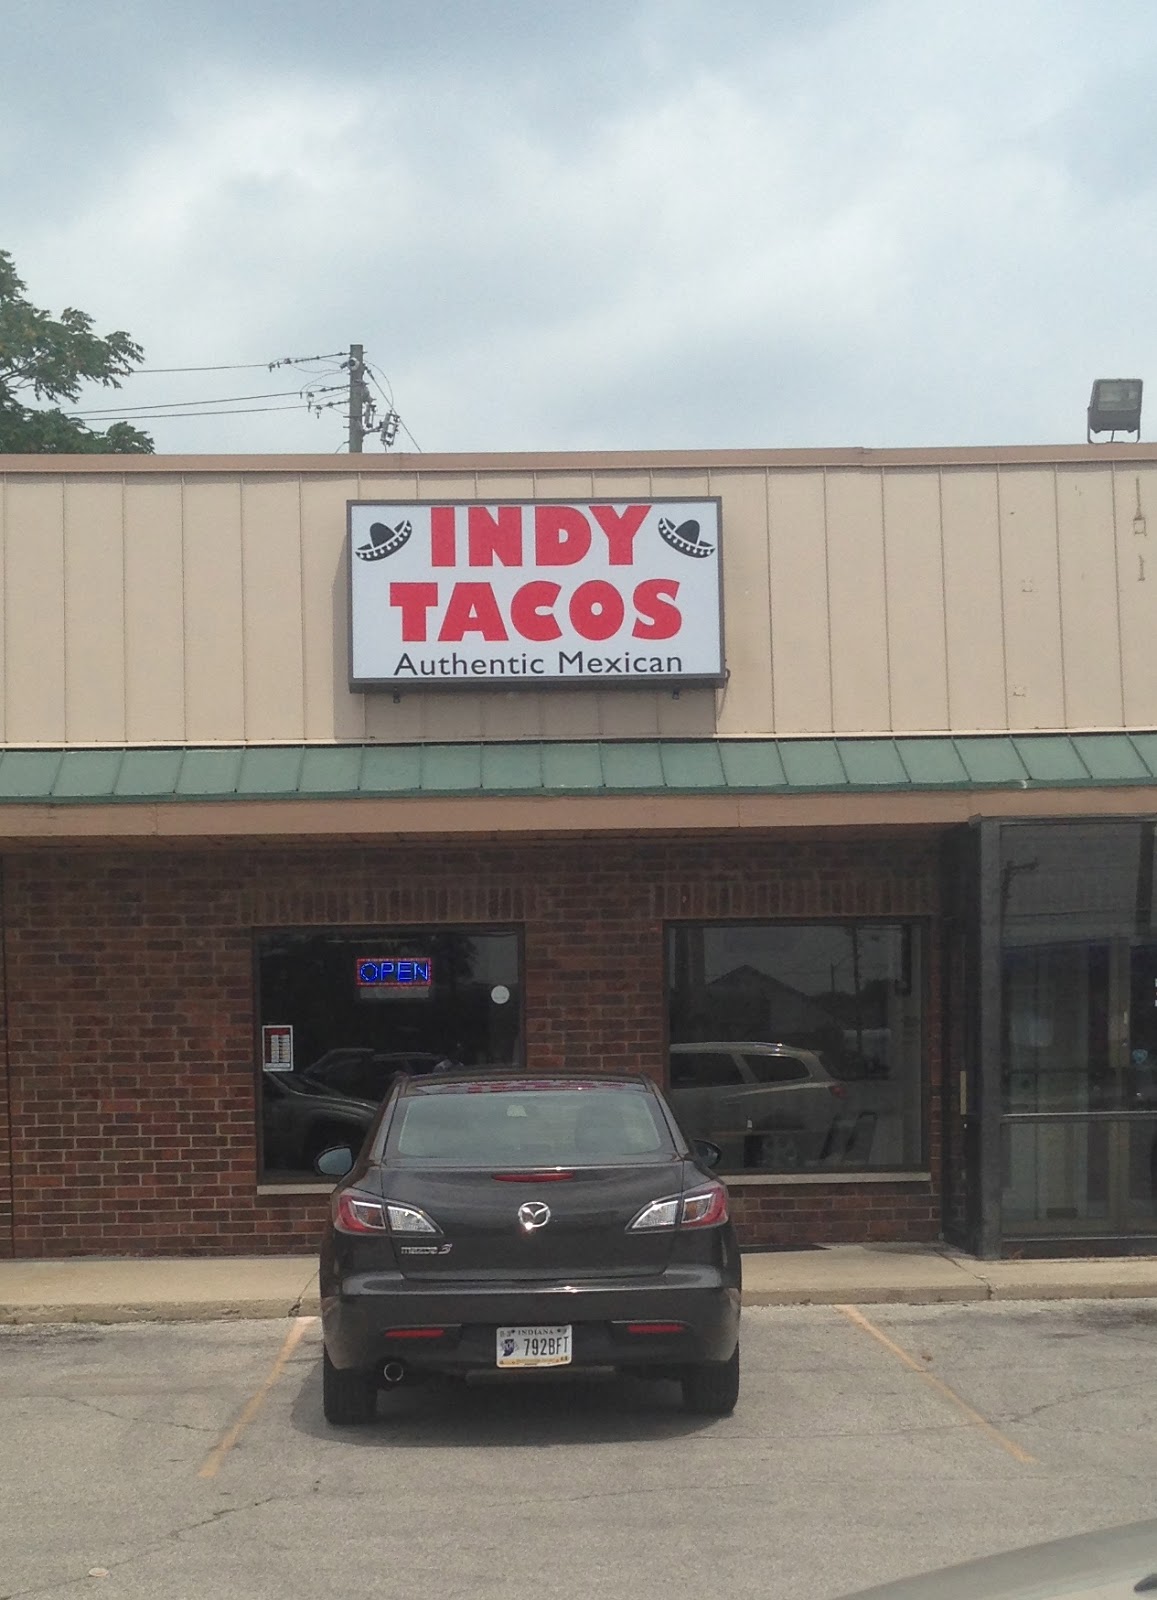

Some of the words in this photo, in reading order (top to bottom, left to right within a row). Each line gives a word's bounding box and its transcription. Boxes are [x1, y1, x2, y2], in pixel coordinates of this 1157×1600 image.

[430, 505, 652, 567] INDY
[389, 578, 683, 642] TACOS
[393, 652, 545, 676] Authentic
[558, 651, 683, 674] Mexican
[360, 962, 428, 982] OPEN
[517, 1328, 554, 1336] INDIANA
[523, 1336, 569, 1356] 792BFT
